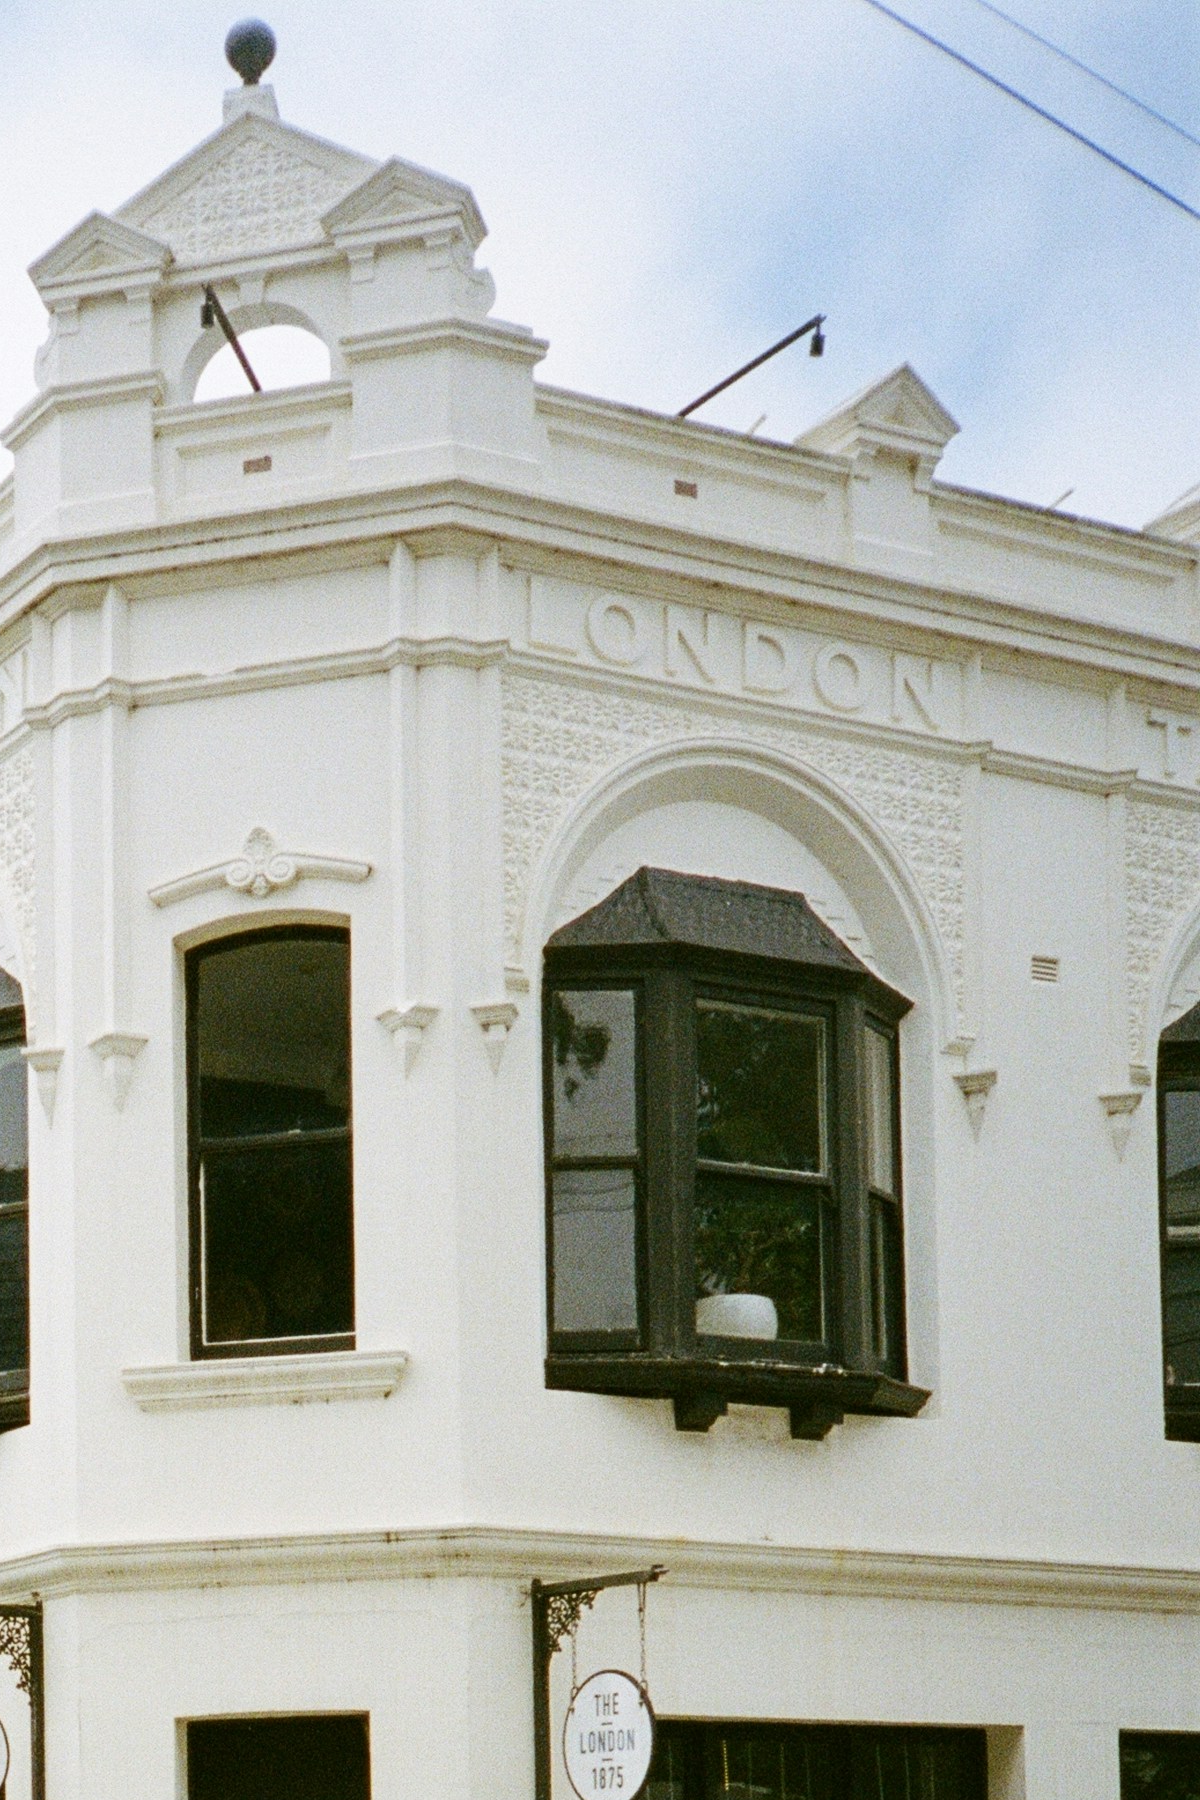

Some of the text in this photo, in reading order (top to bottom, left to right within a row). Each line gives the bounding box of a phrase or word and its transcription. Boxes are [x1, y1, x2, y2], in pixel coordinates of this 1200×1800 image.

[525, 574, 940, 733] LONDON
[594, 1693, 619, 1716] THE
[579, 1729, 636, 1754] LONDON
[592, 1766, 624, 1789] 1875
